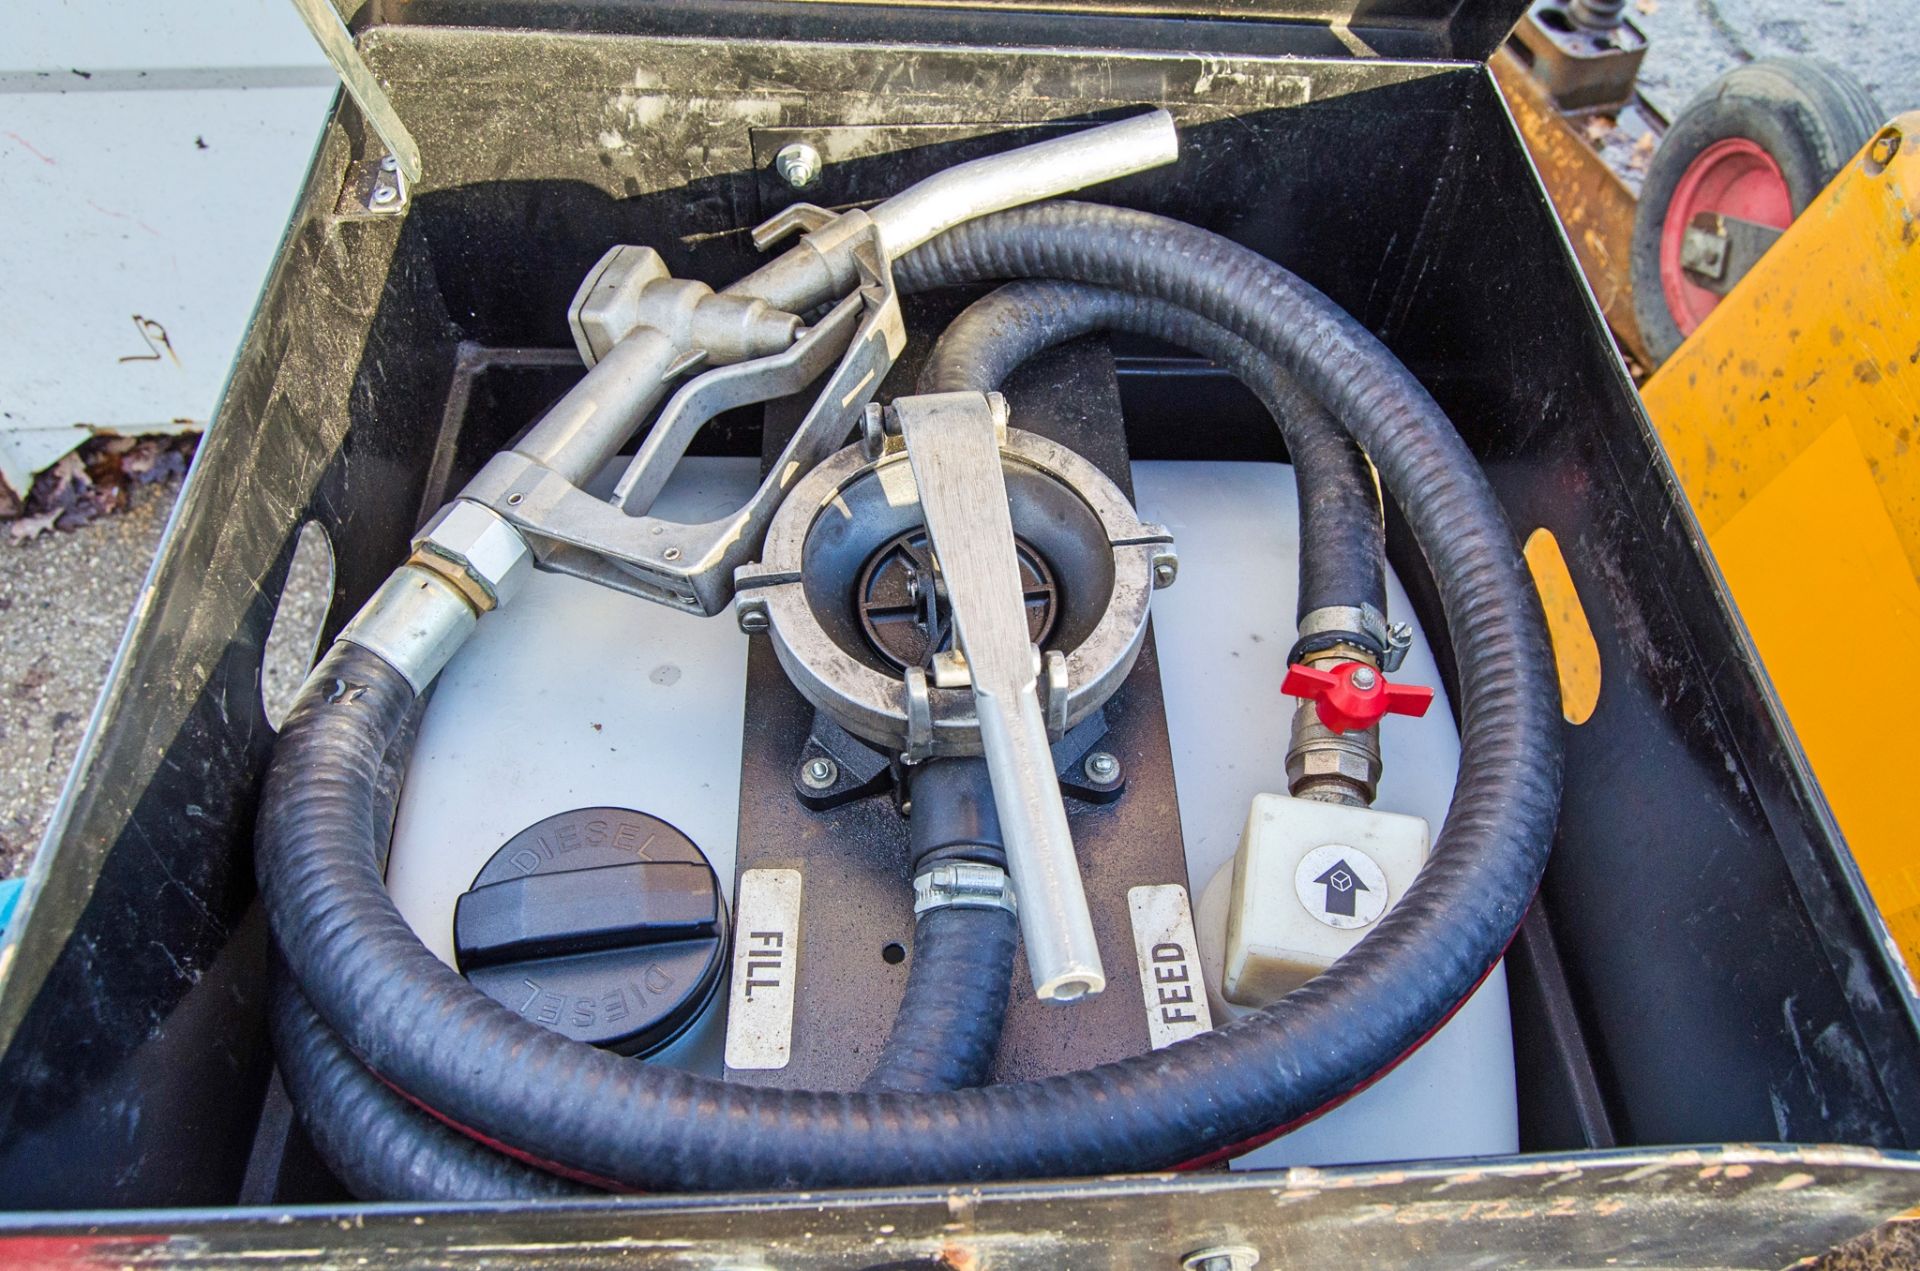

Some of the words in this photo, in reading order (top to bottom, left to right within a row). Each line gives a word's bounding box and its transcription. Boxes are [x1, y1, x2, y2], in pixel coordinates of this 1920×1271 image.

[509, 820, 656, 874] DIESEL
[520, 963, 673, 1027] DIESEL
[746, 931, 783, 997] FILL
[1151, 943, 1197, 1024] FEED
